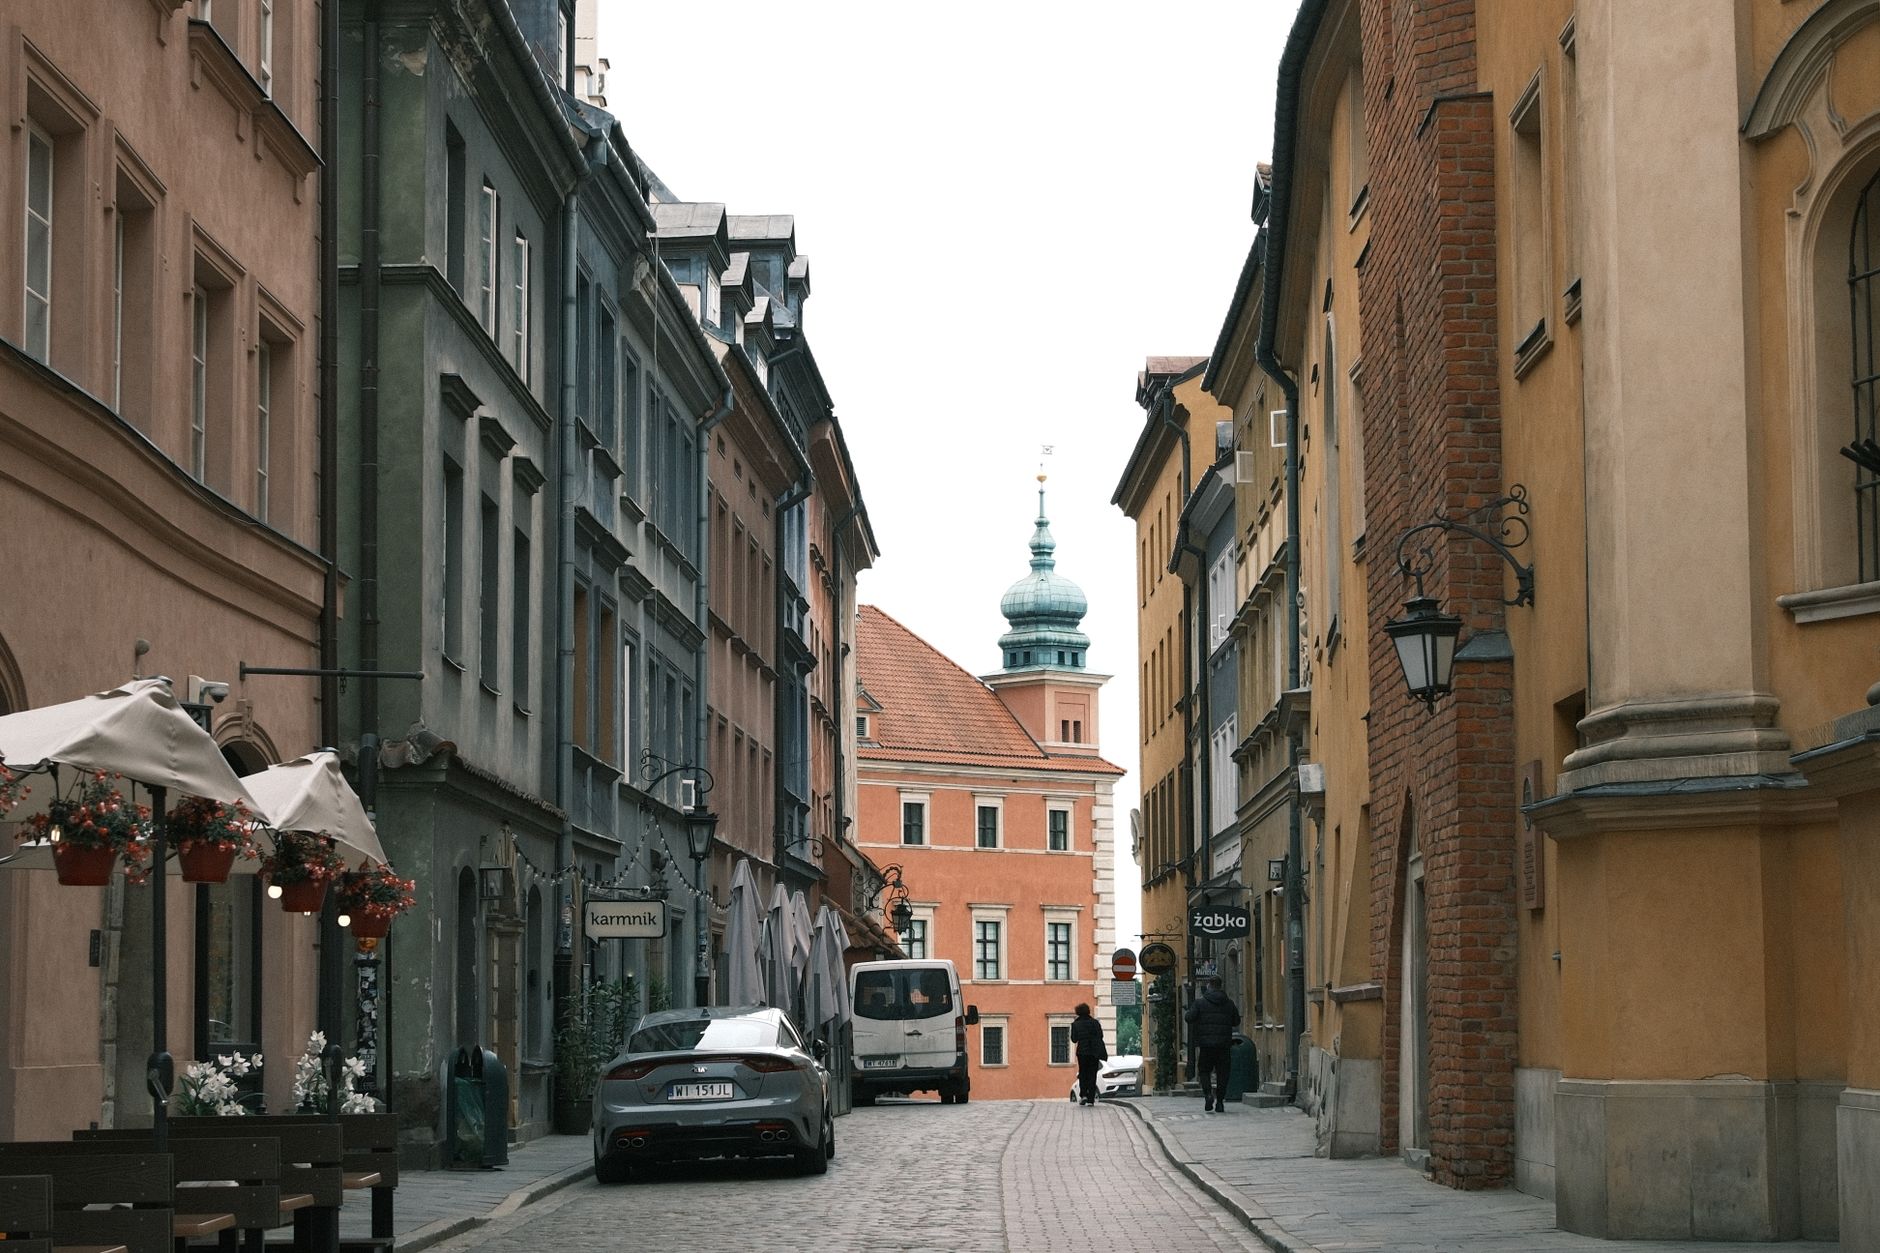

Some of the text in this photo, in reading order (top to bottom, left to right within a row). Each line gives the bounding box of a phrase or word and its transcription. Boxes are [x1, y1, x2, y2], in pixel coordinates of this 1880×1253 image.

[591, 911, 657, 926] karmnik
[1193, 912, 1246, 928] żabka
[675, 1084, 730, 1097] WI 151JL
